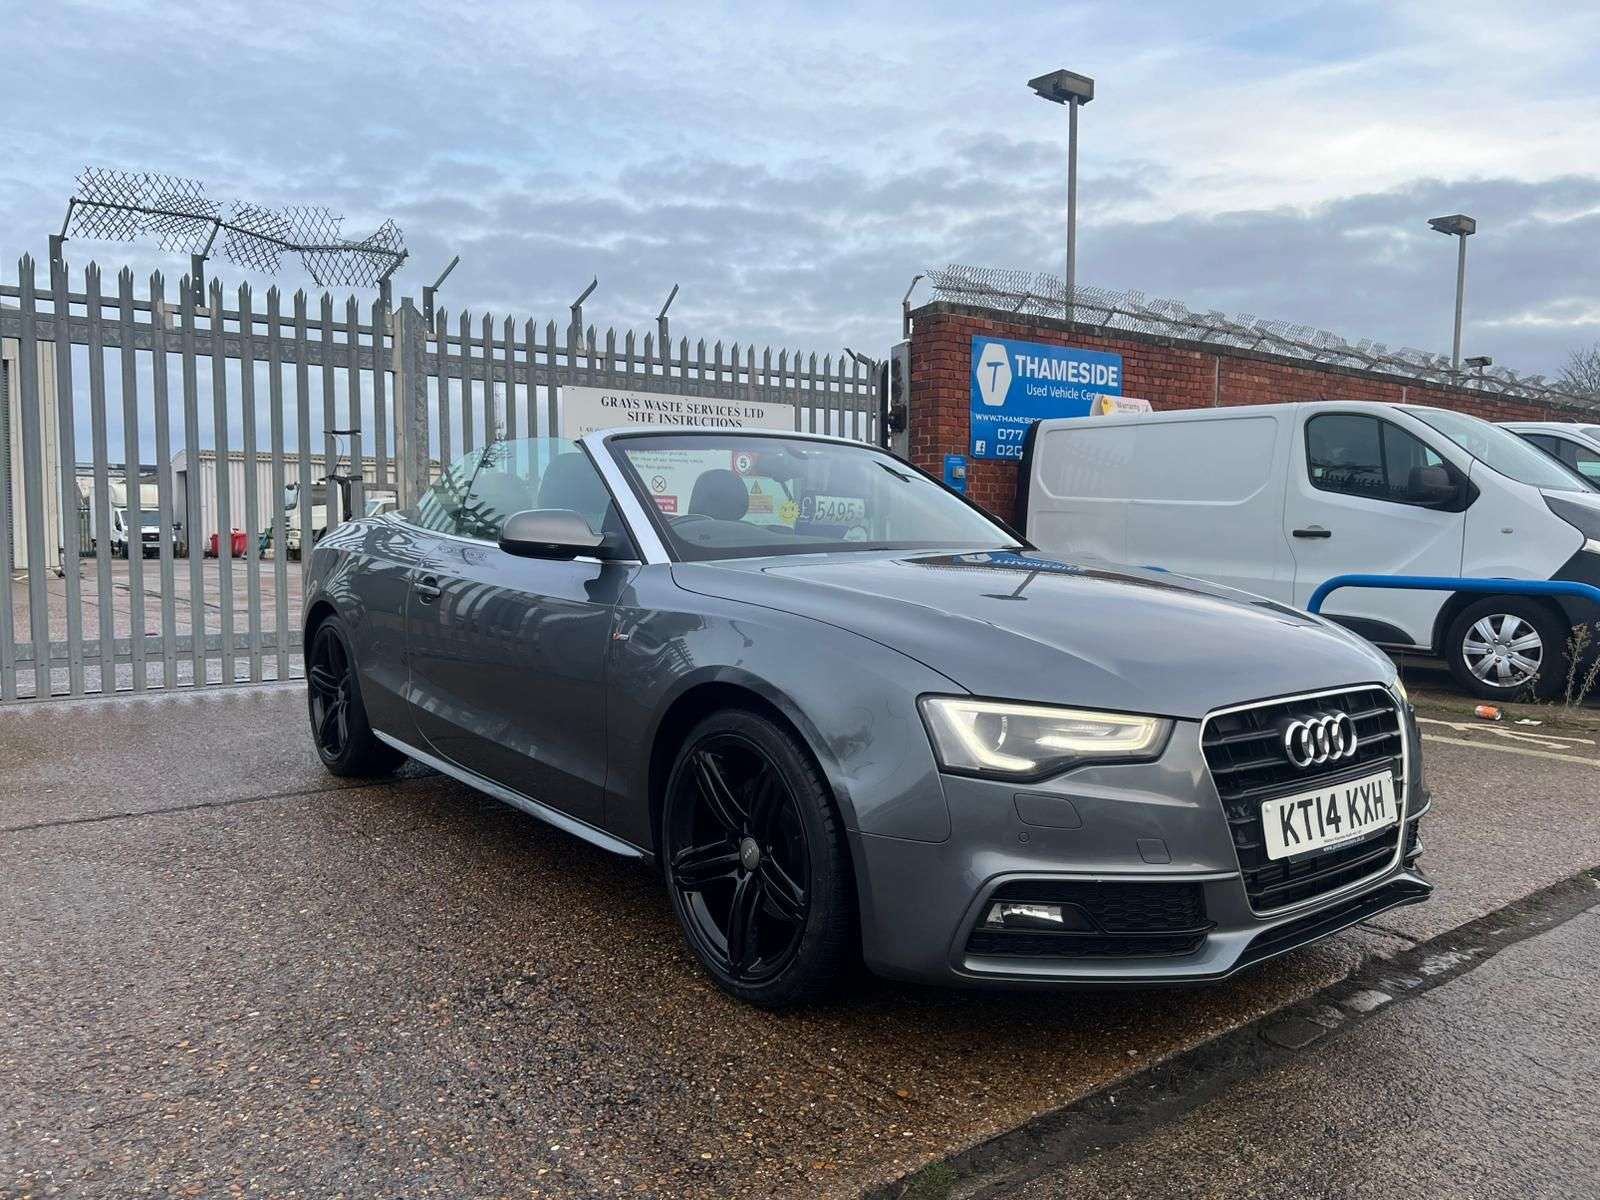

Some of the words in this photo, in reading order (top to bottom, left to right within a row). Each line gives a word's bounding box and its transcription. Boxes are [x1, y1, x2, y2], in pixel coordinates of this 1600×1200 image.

[1014, 355, 1118, 386] THAMESIDE
[1026, 383, 1048, 397] Used
[1049, 386, 1079, 400] Vehicle
[1081, 389, 1099, 401] Cen
[601, 395, 640, 410] GRAYS
[644, 399, 683, 413] WASTE
[687, 403, 741, 417] SERVICES
[744, 407, 764, 419] LTD
[627, 411, 655, 424] SITE
[659, 413, 743, 428] INSTRUCTIONS
[997, 428, 1024, 441] 077
[740, 458, 747, 468] 5
[1279, 793, 1342, 847] KT14
[1346, 780, 1386, 829] KXH
